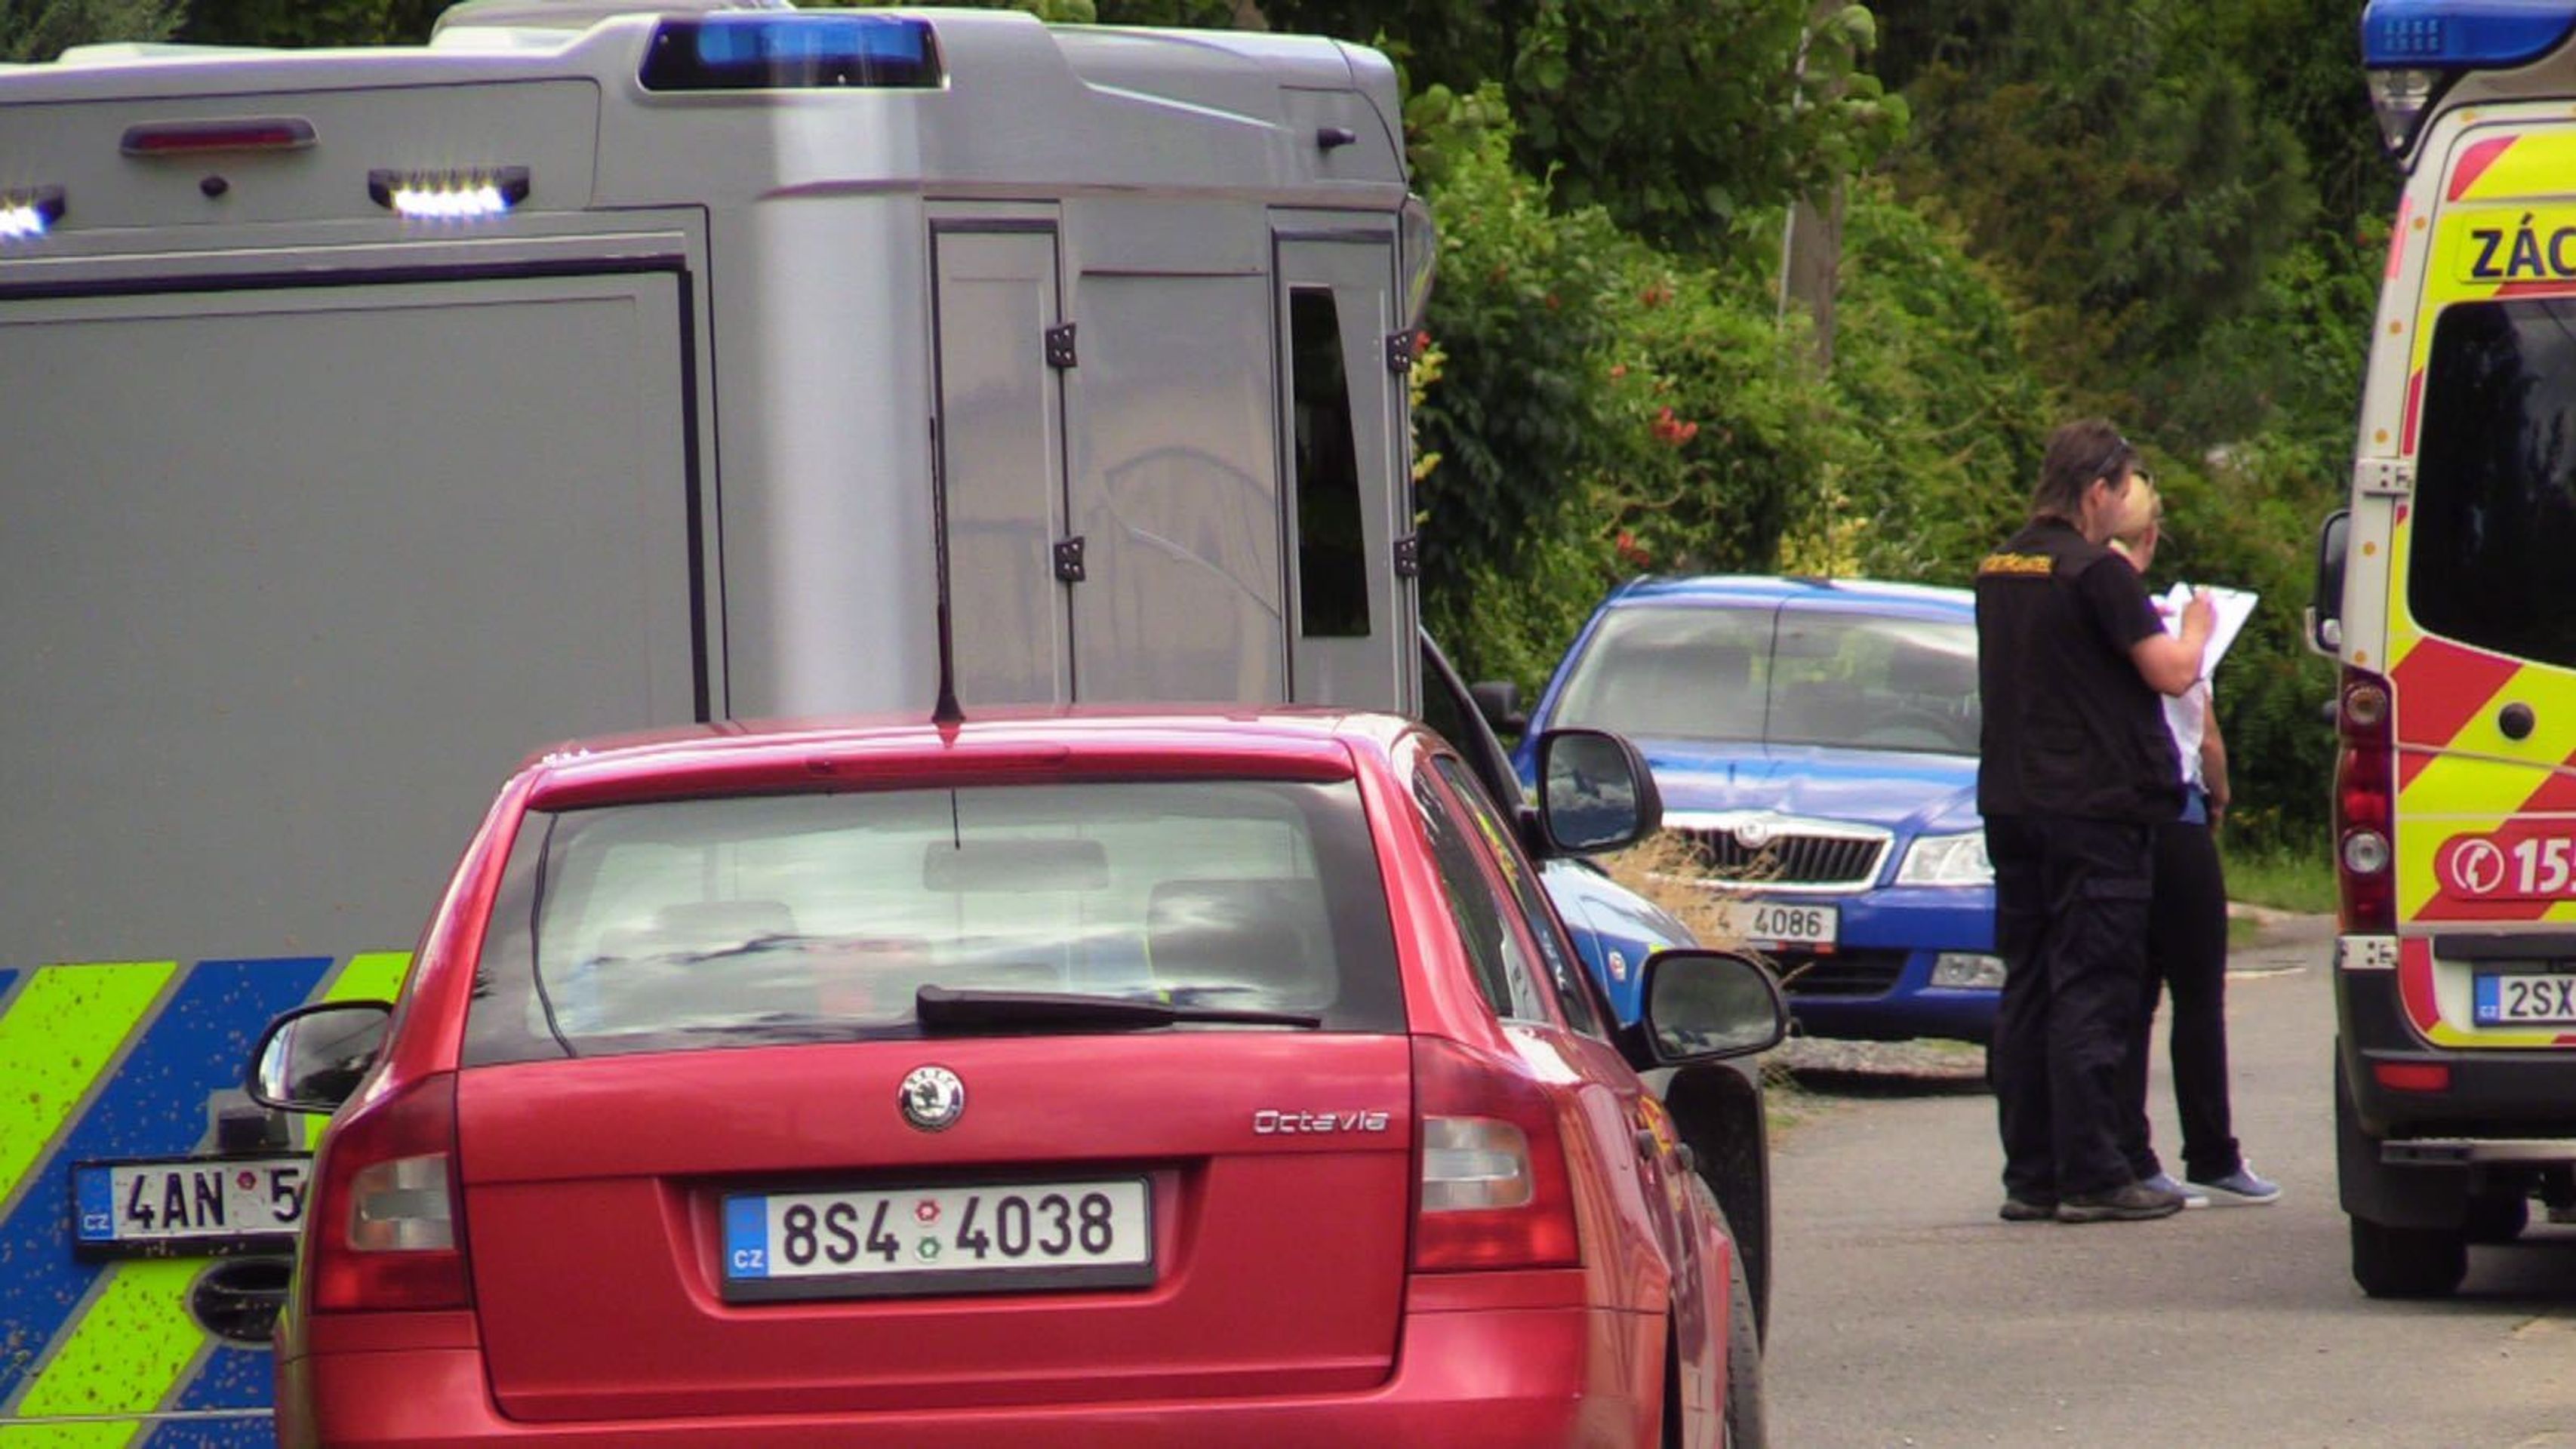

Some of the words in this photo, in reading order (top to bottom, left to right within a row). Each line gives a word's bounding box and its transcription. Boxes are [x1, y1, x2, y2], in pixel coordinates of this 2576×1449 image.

[2514, 838, 2576, 892] 15
[1755, 908, 1821, 936] 4086
[2510, 979, 2574, 1017] 2SX
[1254, 1109, 1388, 1133] Octavia
[128, 1172, 226, 1228] 4AN
[84, 1214, 109, 1229] CZ
[783, 1201, 900, 1266] 8S4
[956, 1192, 1113, 1259] 4038
[734, 1251, 764, 1269] CZ
